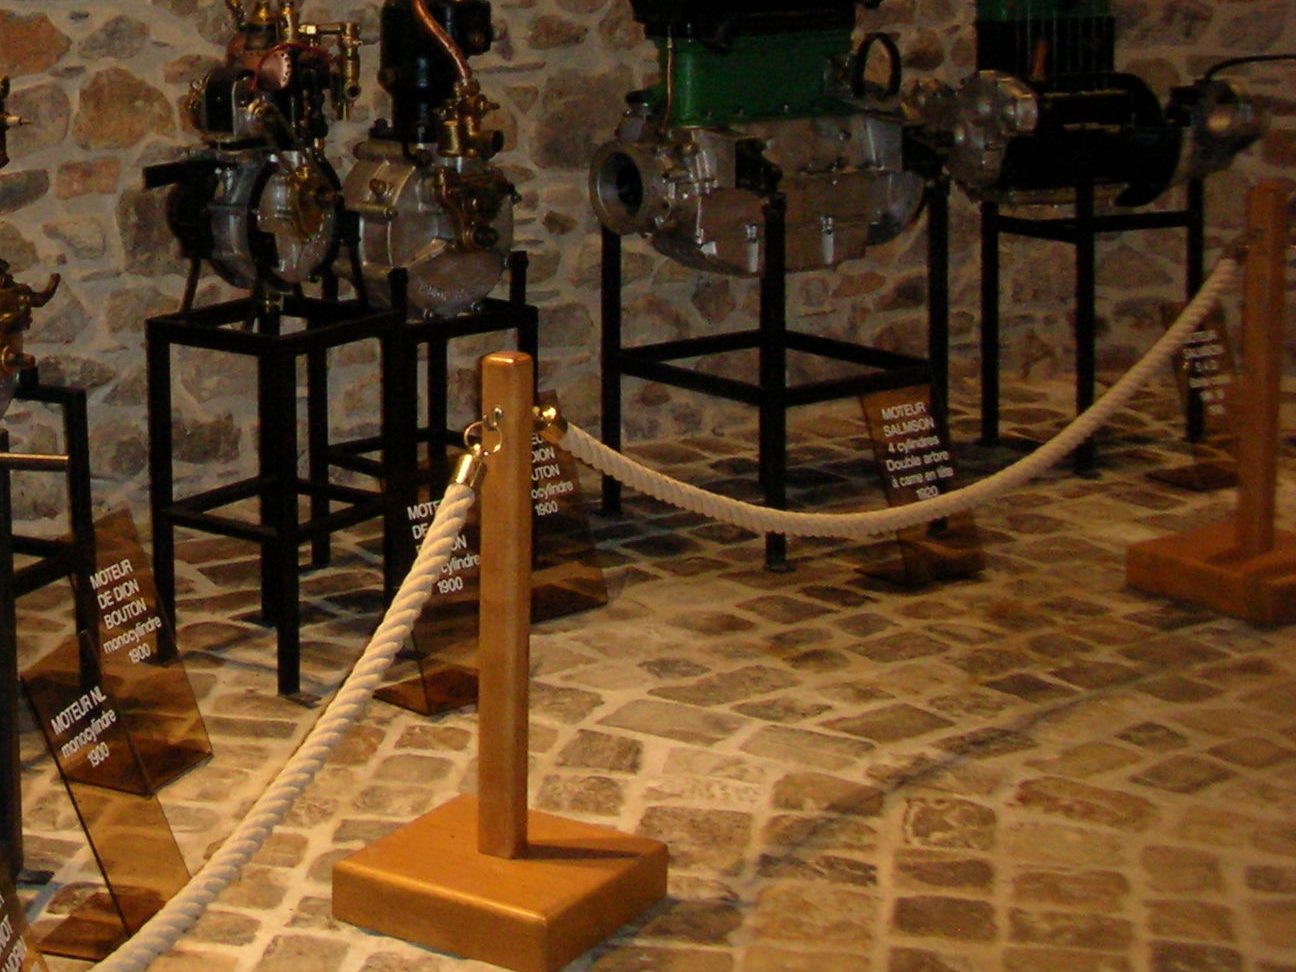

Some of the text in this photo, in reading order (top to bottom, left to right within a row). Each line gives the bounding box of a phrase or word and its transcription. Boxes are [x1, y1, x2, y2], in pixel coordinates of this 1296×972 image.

[881, 401, 926, 420] MOTEUR
[883, 416, 935, 437] SALMSON
[888, 435, 940, 454] 4 cylindres
[886, 450, 949, 472] Double arbre
[534, 501, 558, 516] 1900
[89, 559, 133, 590] MOTEUR
[436, 577, 464, 594] 1900
[97, 578, 140, 609] DE DION
[104, 597, 147, 630] BOUTON
[103, 616, 162, 654] monocylindre
[128, 643, 151, 664] 1900
[50, 686, 107, 735] MOTEUR NL
[61, 709, 116, 758] monocylindre
[87, 741, 110, 768] 1900
